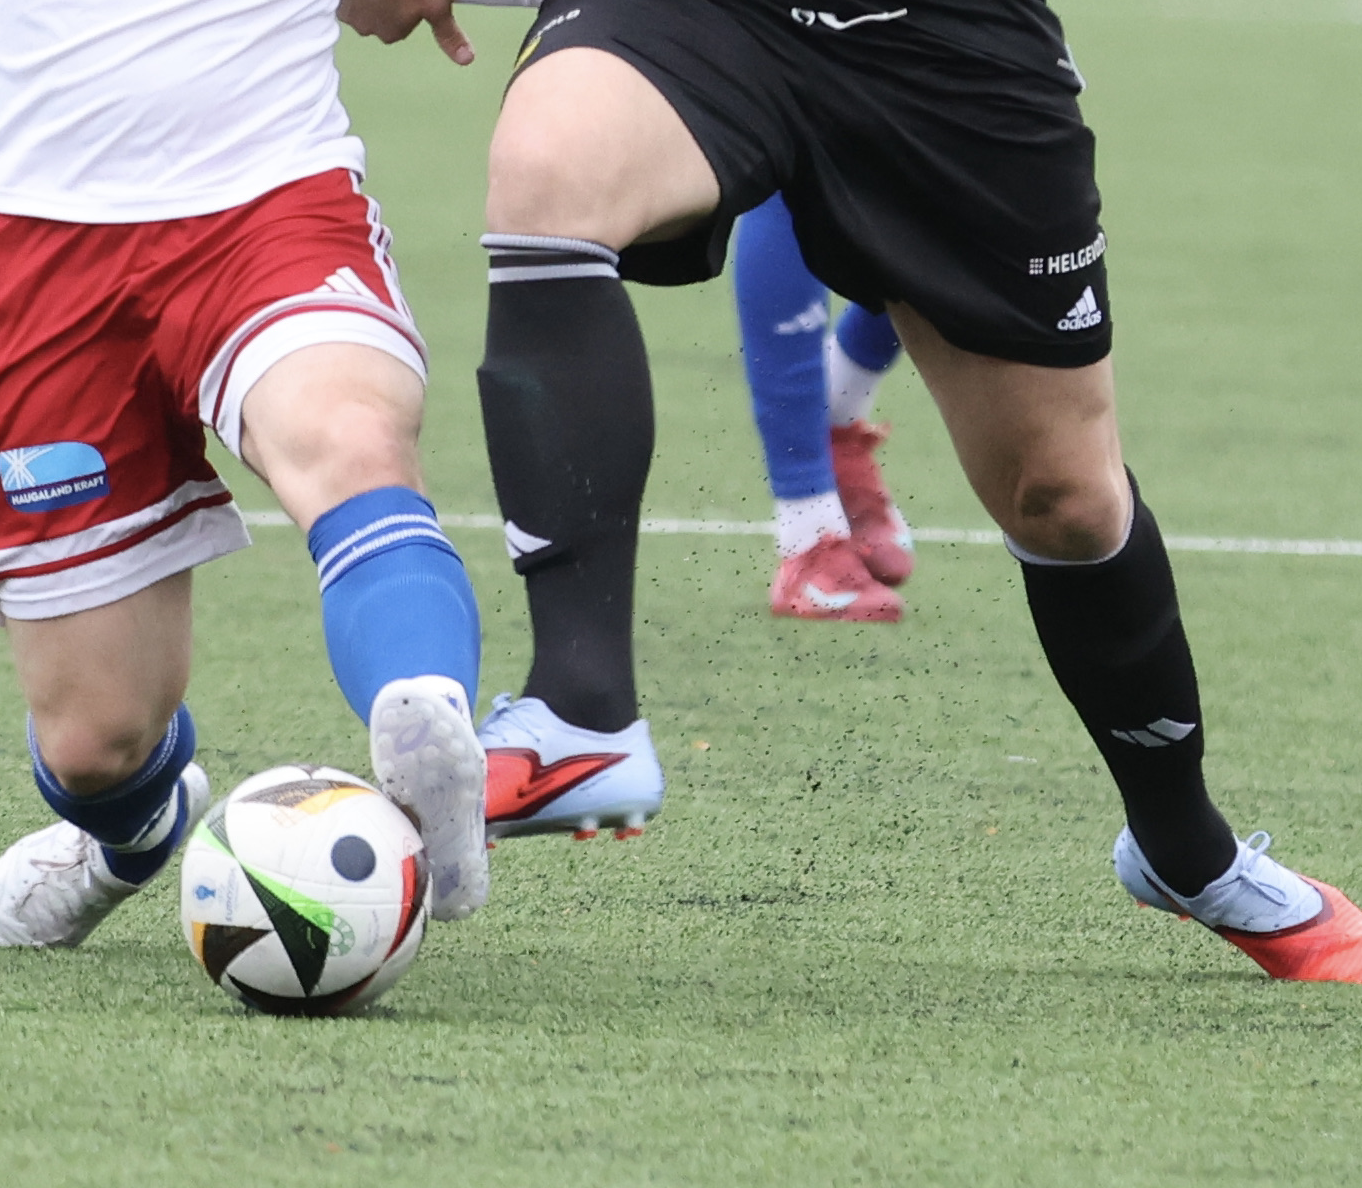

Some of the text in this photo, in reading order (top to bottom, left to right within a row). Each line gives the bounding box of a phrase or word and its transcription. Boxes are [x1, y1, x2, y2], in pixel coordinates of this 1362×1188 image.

[1057, 310, 1103, 331] adidas
[11, 476, 105, 506] HAUGALAND KRAFT
